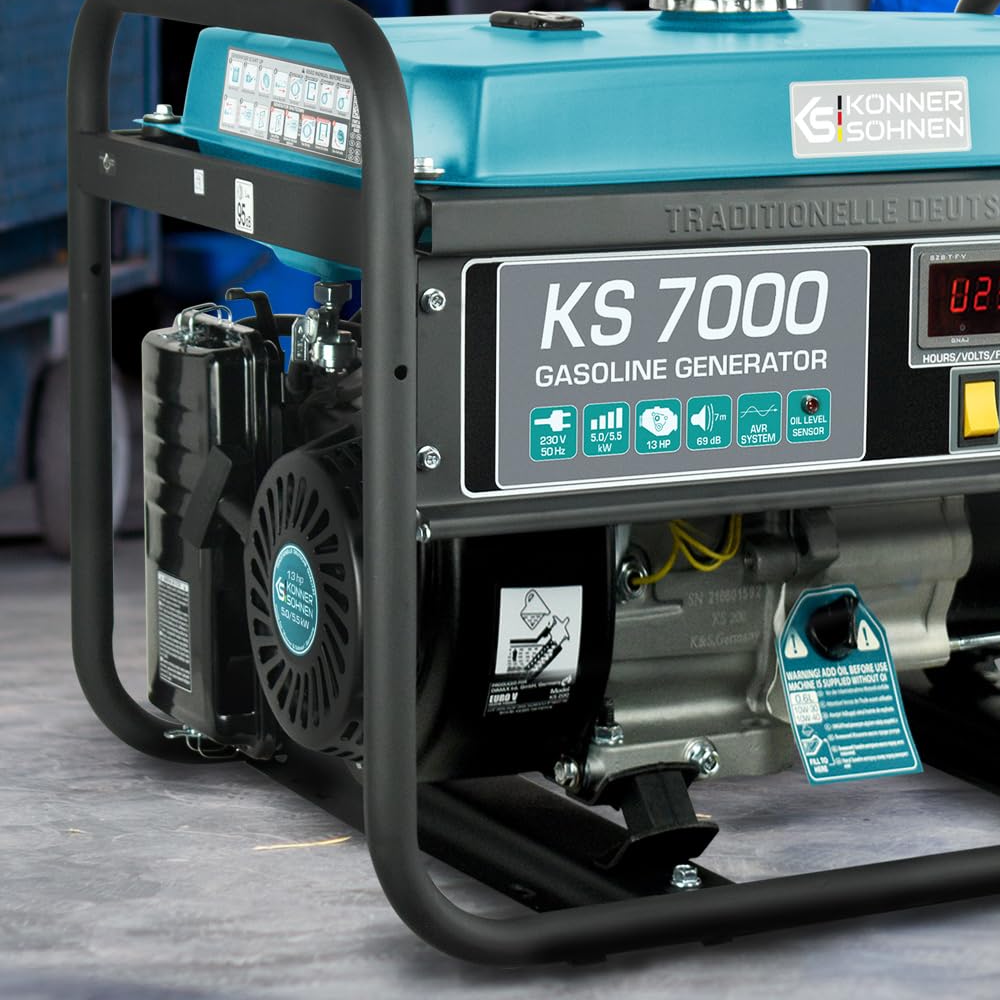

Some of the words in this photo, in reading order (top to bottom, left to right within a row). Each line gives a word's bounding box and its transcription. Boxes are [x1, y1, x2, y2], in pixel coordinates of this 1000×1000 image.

[665, 198, 898, 234] TRADITIONELLE
[541, 278, 635, 350] KS
[656, 270, 829, 343] 7000
[535, 358, 667, 388] GASOLINE
[674, 349, 828, 379] GENERATOR
[790, 415, 802, 425] OIL
[803, 413, 827, 425] LEVEL
[750, 423, 768, 434] AVR
[792, 426, 825, 437] SENSOR
[539, 435, 559, 446] 230
[559, 434, 567, 444] V
[590, 431, 623, 443] 5.0/5.5
[696, 436, 708, 446] 69
[709, 435, 721, 445] dB
[741, 432, 776, 445] SYSTEM
[597, 442, 612, 453] kW
[646, 440, 658, 450] 13
[658, 439, 671, 449] HP
[540, 447, 553, 457] 50
[554, 446, 566, 456] Hz
[286, 570, 296, 581] 13
[296, 573, 305, 586] hp
[821, 666, 837, 678] ADD
[837, 665, 849, 676] OIL
[848, 662, 876, 675] BEFORE
[874, 661, 889, 672] USE
[788, 679, 816, 691] MACHINE
[816, 679, 823, 688] IS
[822, 676, 852, 688] SUPPLIED
[852, 673, 878, 686] WITHOUT
